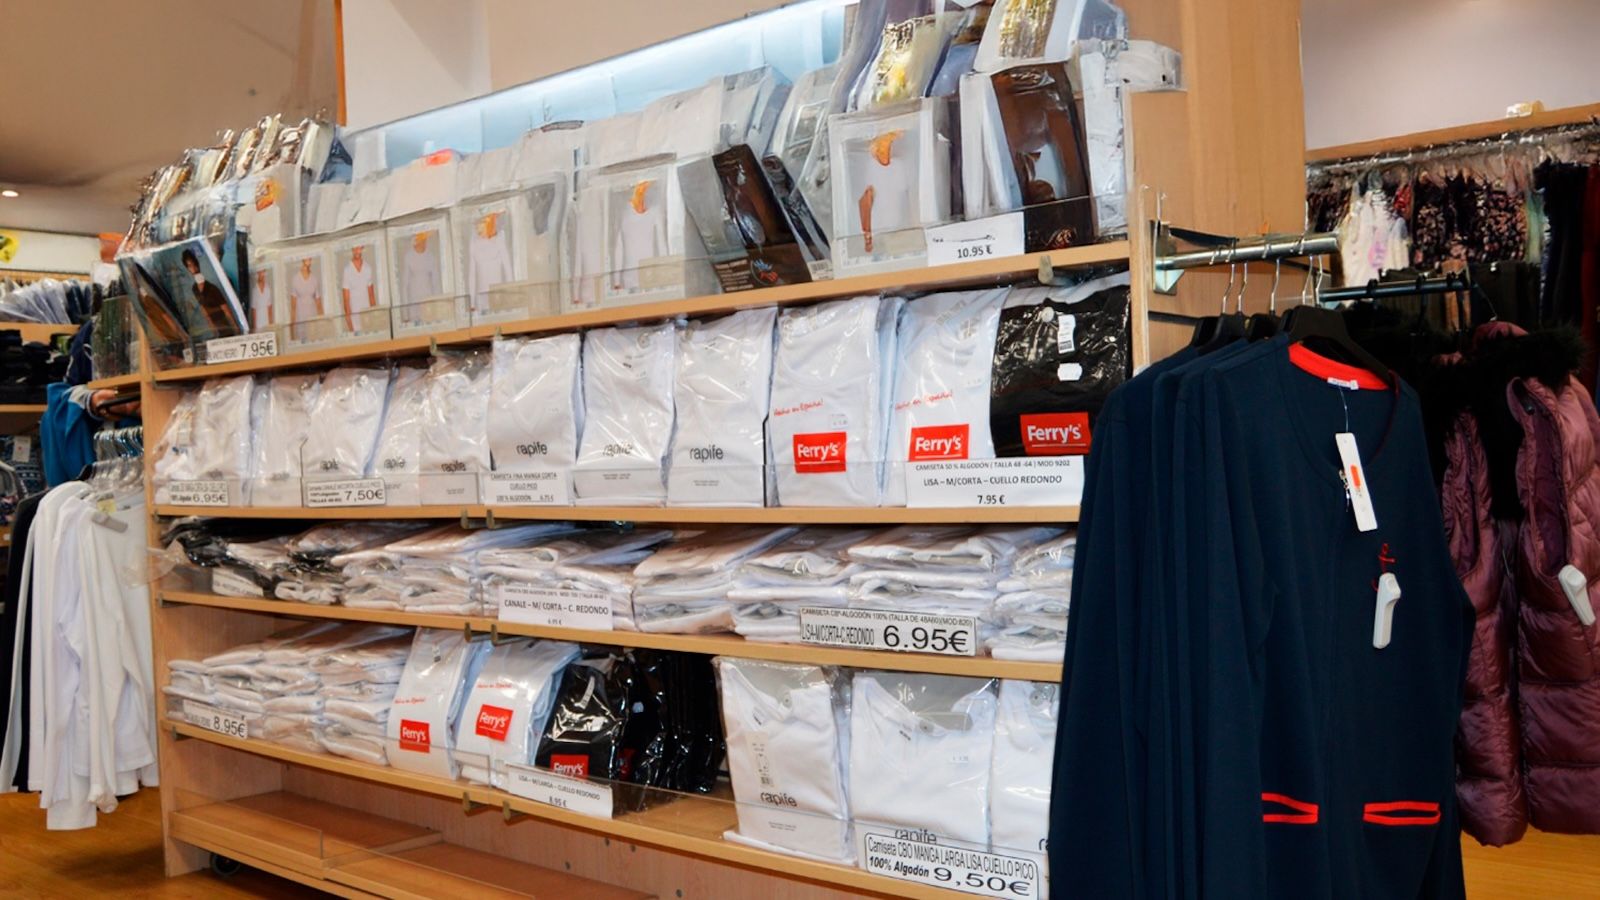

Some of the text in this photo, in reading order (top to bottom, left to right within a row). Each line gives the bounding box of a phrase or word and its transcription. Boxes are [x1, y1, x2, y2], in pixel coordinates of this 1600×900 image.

[957, 246, 984, 258] 10.95
[240, 340, 275, 358] 7.95€
[1027, 425, 1082, 443] Ferry's
[516, 441, 548, 457] rapife
[689, 444, 724, 462] rapife
[797, 443, 839, 461] Ferry's
[915, 436, 962, 455] Ferry's
[916, 463, 944, 471] CAMISETA
[923, 478, 939, 486] LISA
[946, 477, 982, 486] M/CORTA
[989, 476, 1019, 484] CUELLO
[1020, 475, 1062, 484] REDONDO
[344, 489, 384, 502] 7,50€
[977, 494, 1005, 504] 7.95 €
[504, 599, 526, 608] CANALE
[542, 602, 562, 611] CORTA
[576, 605, 609, 615] REDONDO
[883, 625, 968, 652] 6.95€
[213, 716, 246, 738] 8.95€
[480, 711, 506, 728] Ferry's
[402, 727, 426, 742] Ferry's
[760, 791, 797, 808] rapife
[868, 836, 1034, 880] Camiseta CBO MANGA LARGA LISA CUELLO PICO
[869, 855, 1031, 896] 100% Algodón 9,50€
